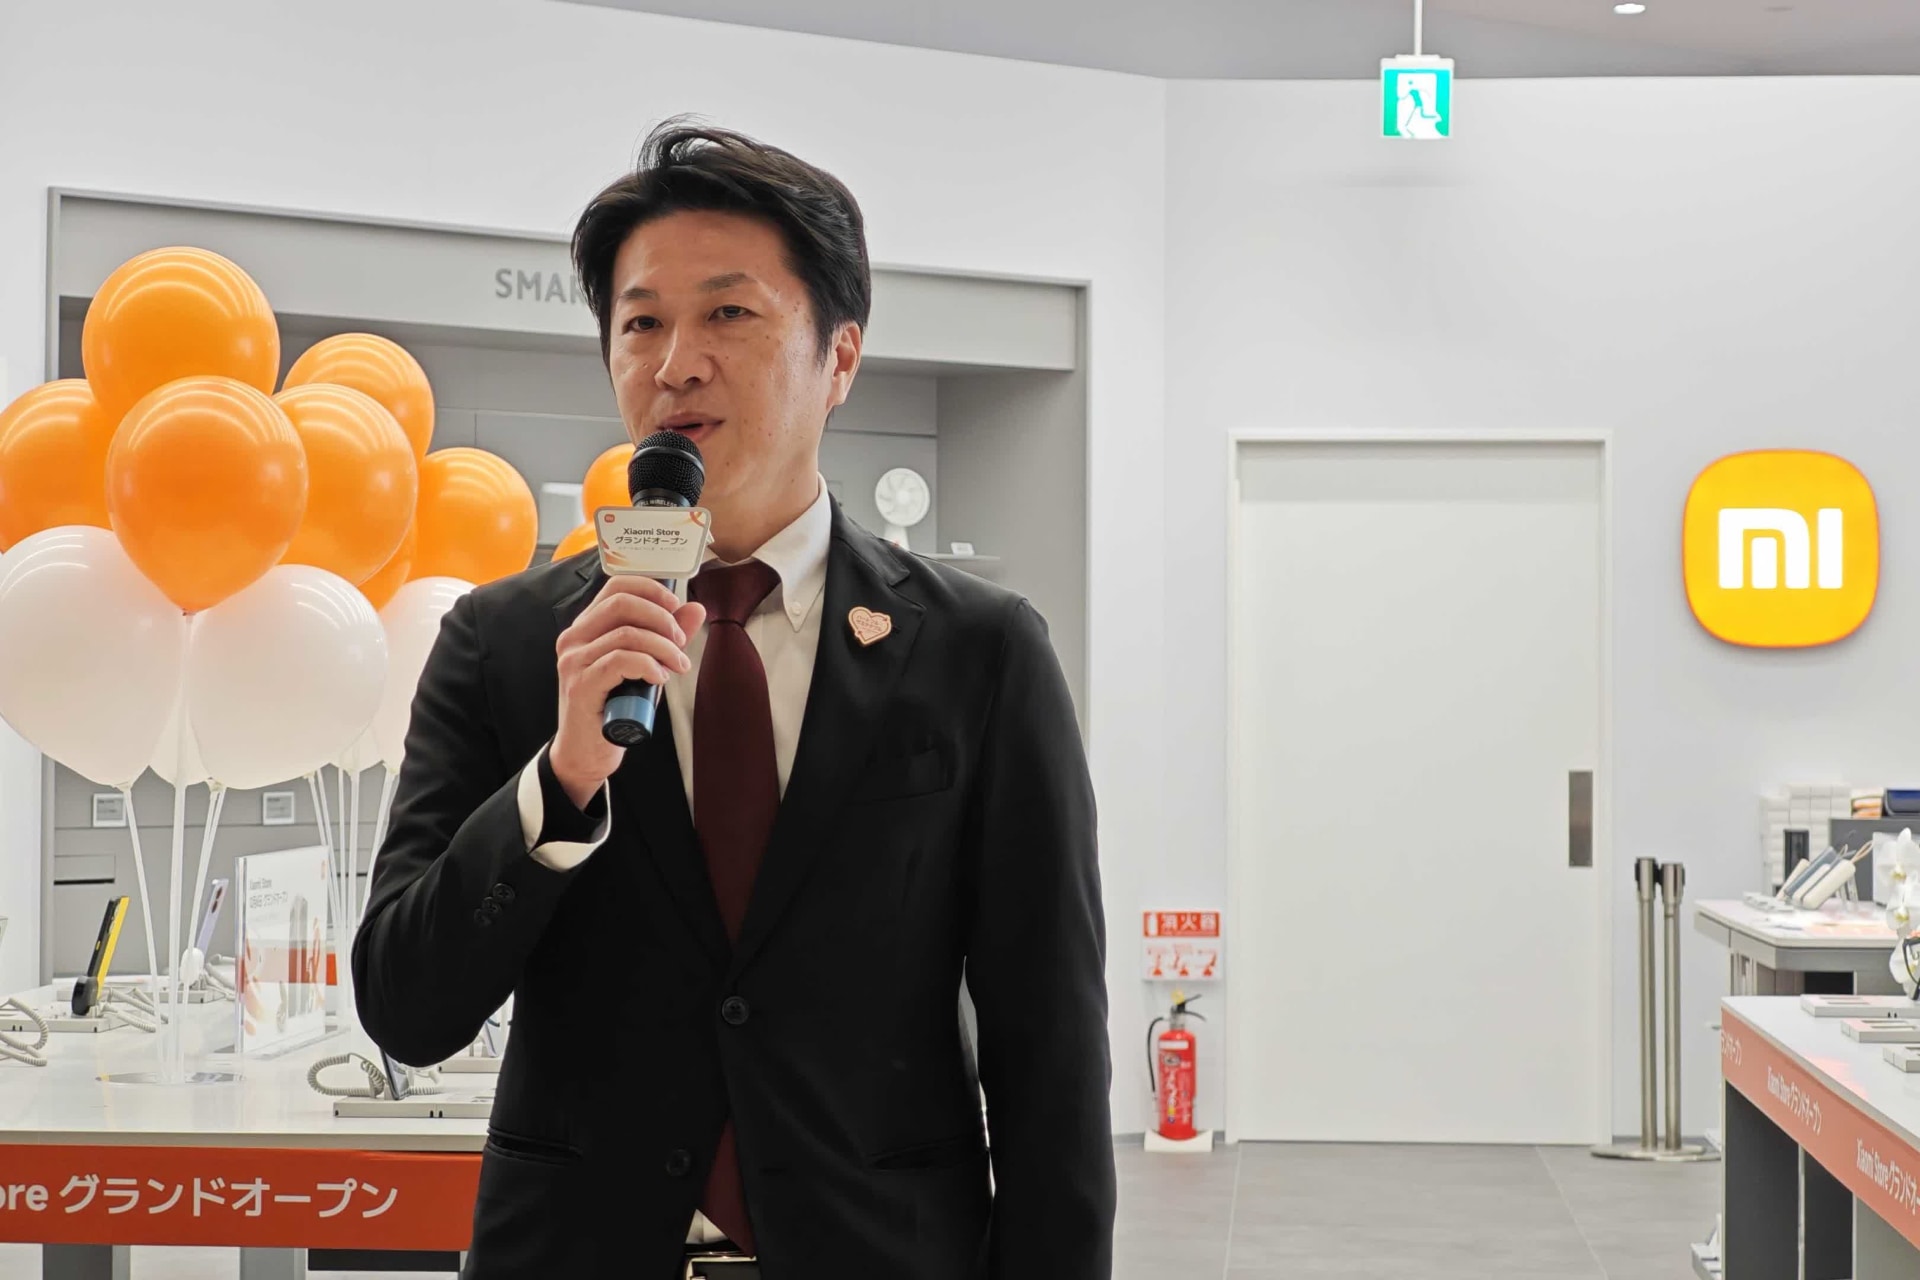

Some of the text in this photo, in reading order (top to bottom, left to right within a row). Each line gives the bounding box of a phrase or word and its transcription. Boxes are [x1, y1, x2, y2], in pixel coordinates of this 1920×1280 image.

[623, 527, 680, 536] Xiaomi Store
[615, 536, 688, 545] グランドオープン
[0, 1173, 398, 1218] re グランドオープン
